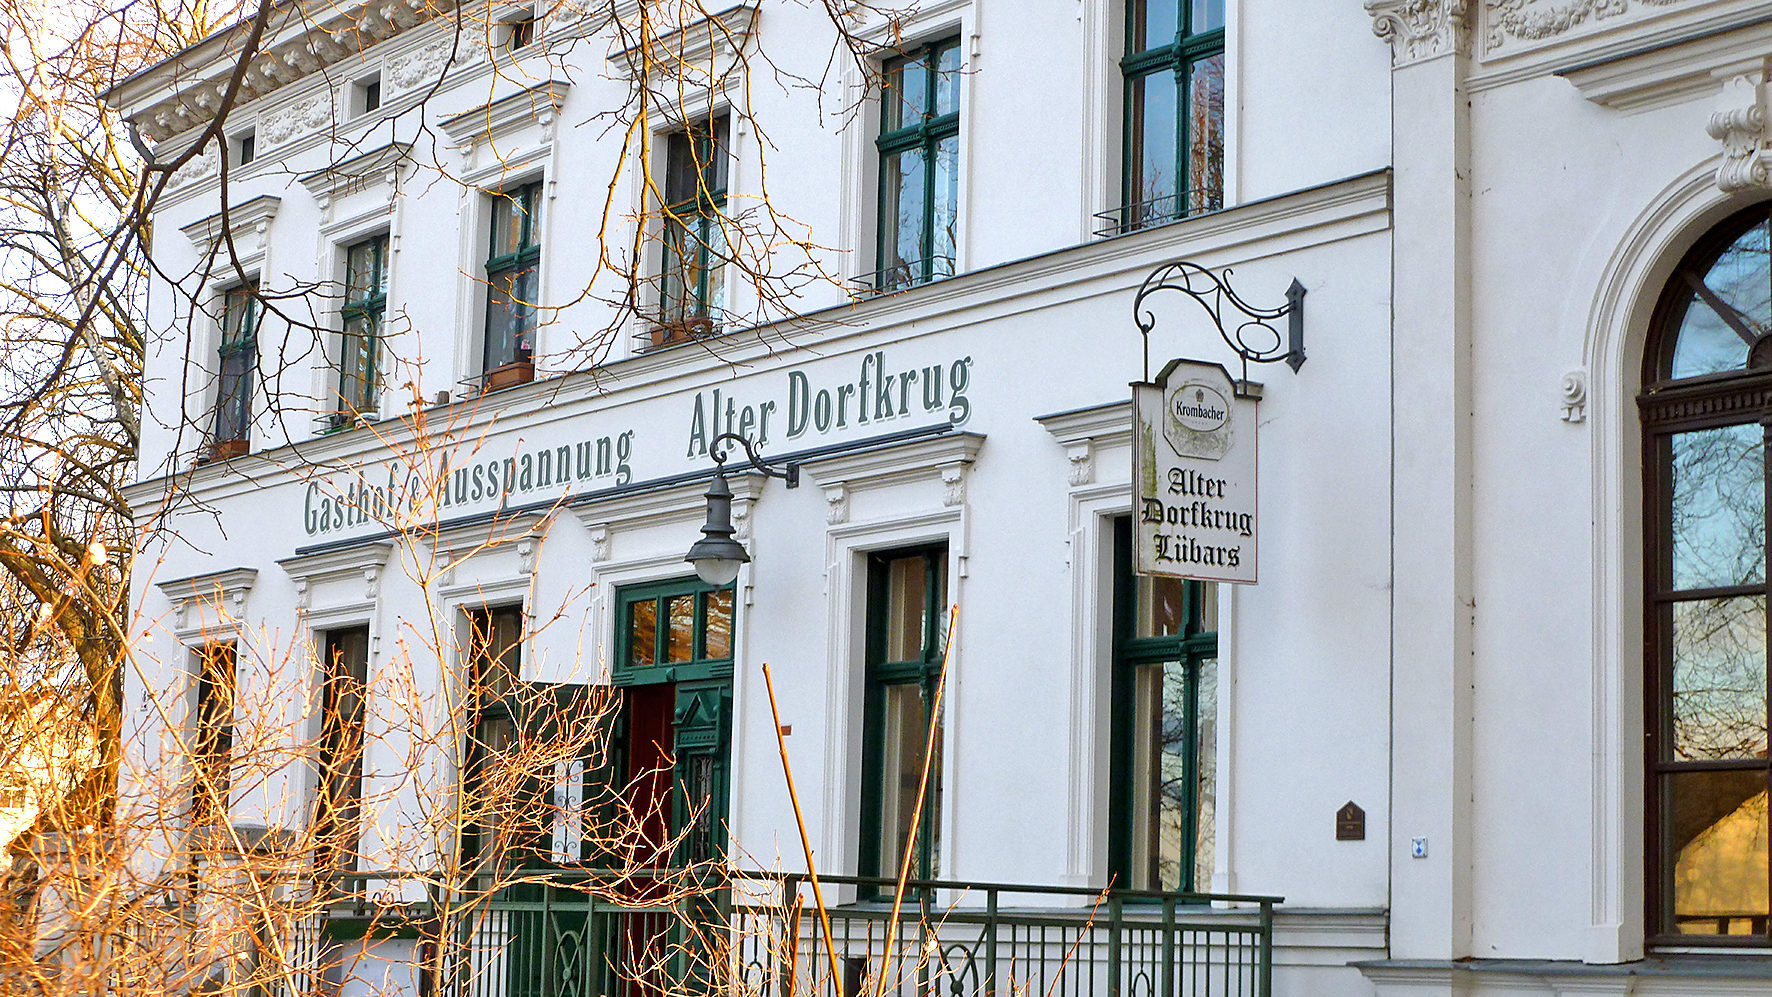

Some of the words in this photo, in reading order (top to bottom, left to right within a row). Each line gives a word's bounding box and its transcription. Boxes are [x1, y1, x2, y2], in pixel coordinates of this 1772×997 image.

[687, 388, 775, 458] Alter
[786, 351, 972, 424] Dorfkrug
[1176, 400, 1225, 421] Krombacher
[304, 462, 399, 535] Gasthof
[437, 429, 634, 509] Ausspannung
[1167, 467, 1227, 499] Alter
[1141, 496, 1253, 537] Dorfkrug
[1153, 534, 1240, 567] Lübars
